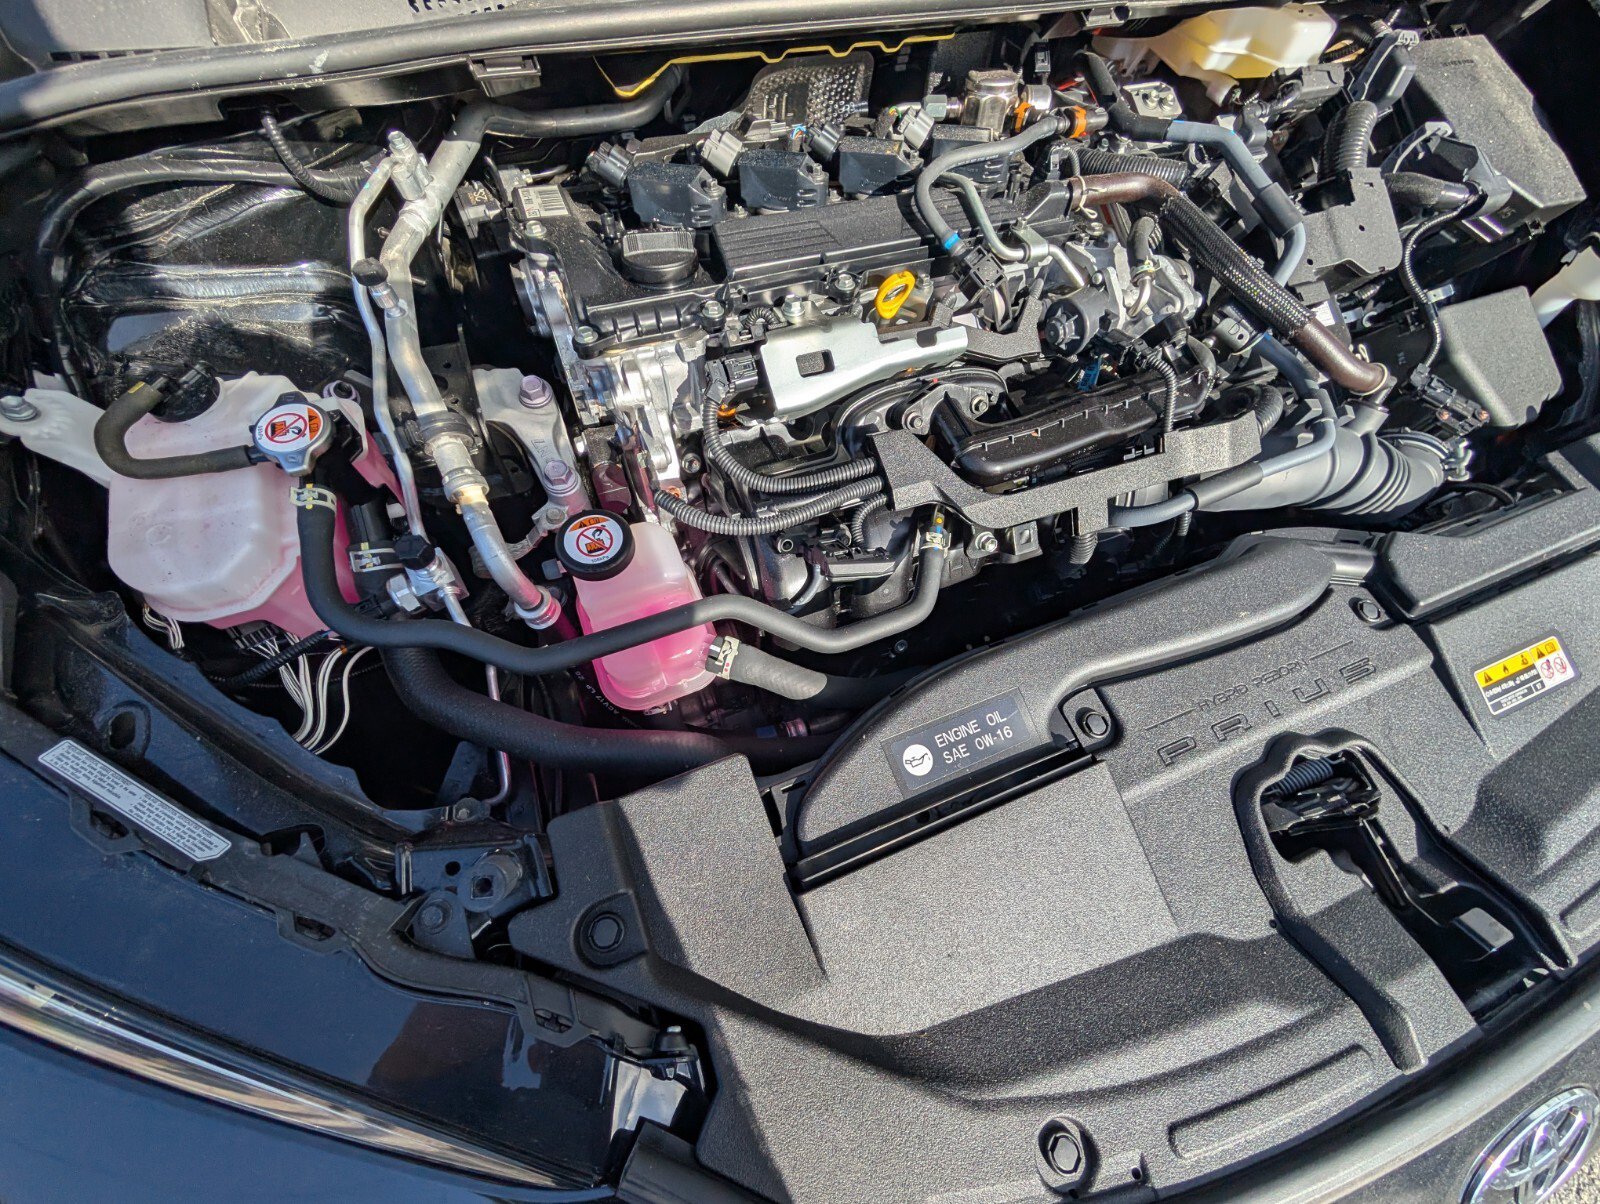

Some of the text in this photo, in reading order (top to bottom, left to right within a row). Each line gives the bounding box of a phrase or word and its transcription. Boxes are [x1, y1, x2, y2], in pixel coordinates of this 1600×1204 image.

[1199, 660, 1309, 711] HYBRID REBORN
[934, 710, 1007, 748] ENGINE OIL
[1157, 657, 1377, 767] PRIUS
[943, 725, 1013, 764] SAE 0W-16
